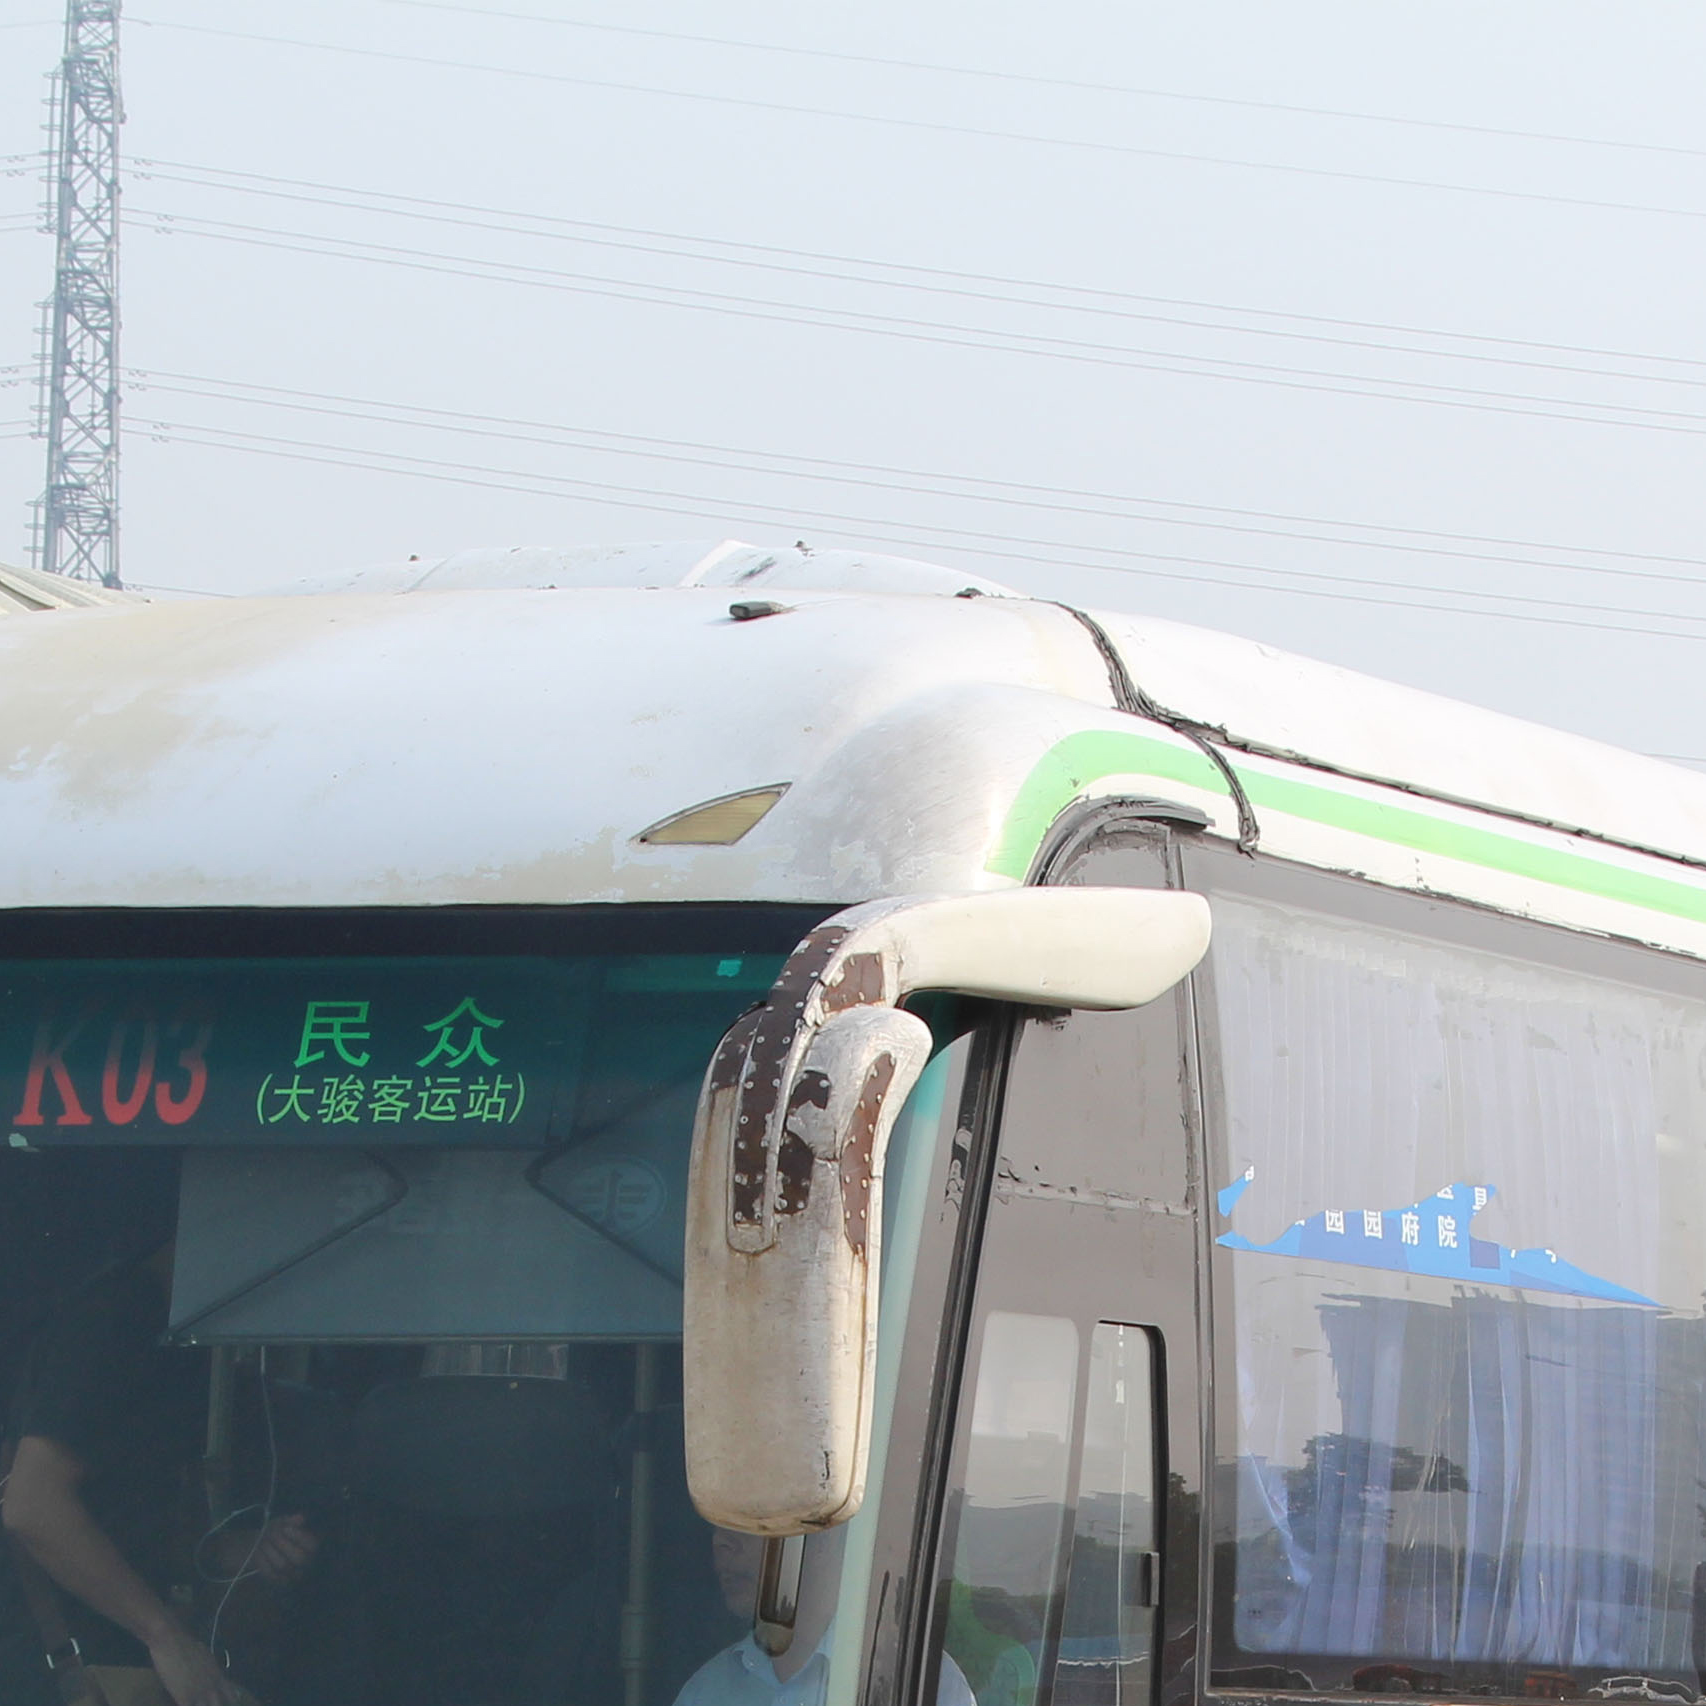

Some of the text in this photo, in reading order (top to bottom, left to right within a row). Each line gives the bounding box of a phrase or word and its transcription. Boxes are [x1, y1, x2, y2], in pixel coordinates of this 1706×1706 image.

[13, 1012, 216, 1128] K03
[293, 998, 505, 1068] 民众
[254, 1071, 528, 1127] (大骏客运站)
